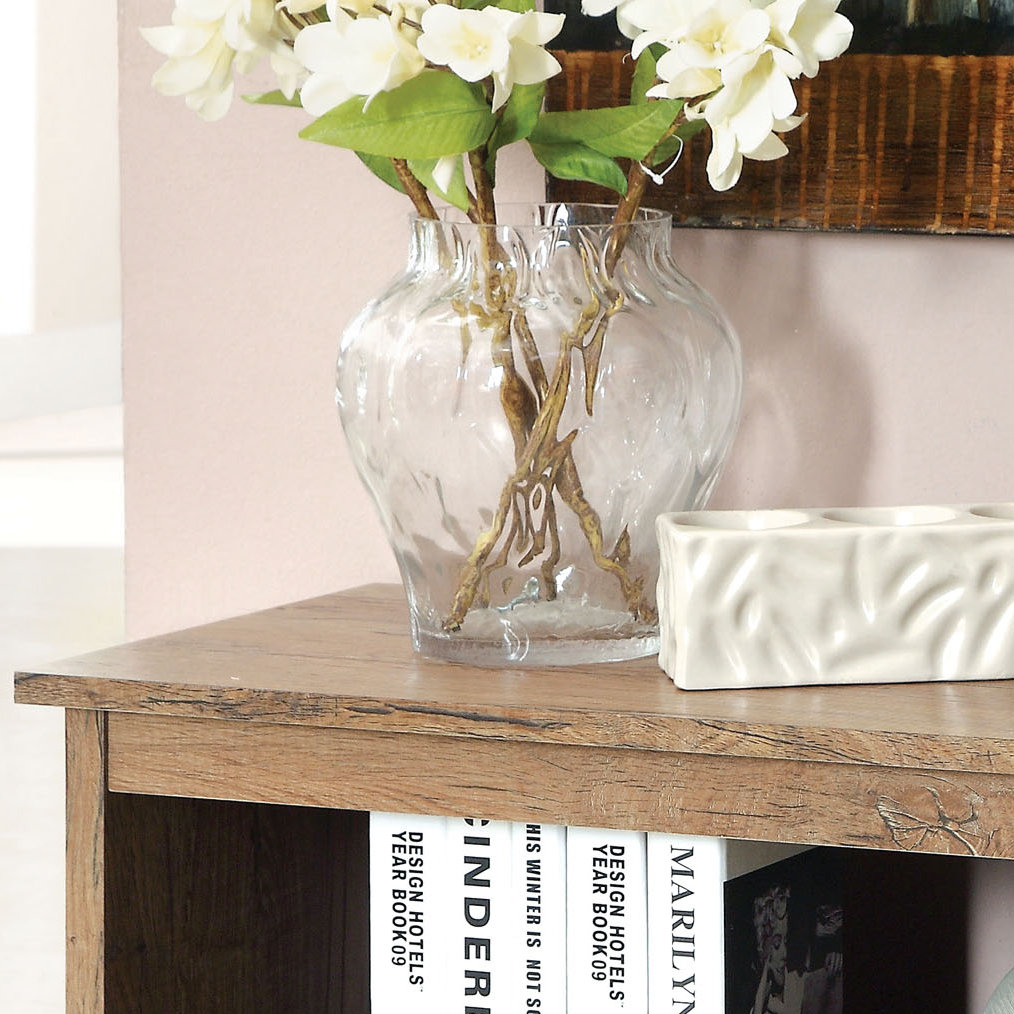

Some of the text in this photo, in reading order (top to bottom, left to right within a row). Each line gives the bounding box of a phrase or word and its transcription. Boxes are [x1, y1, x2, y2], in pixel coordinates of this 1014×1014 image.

[391, 831, 407, 880] YEAR
[525, 823, 541, 853] HIS
[525, 859, 541, 926] WINTER
[592, 844, 608, 894] YEAR
[408, 831, 424, 985] DESIGN HOTELS
[609, 845, 625, 1001] DESIGN HOTELS
[525, 931, 541, 948] IS
[526, 959, 541, 993] NOT
